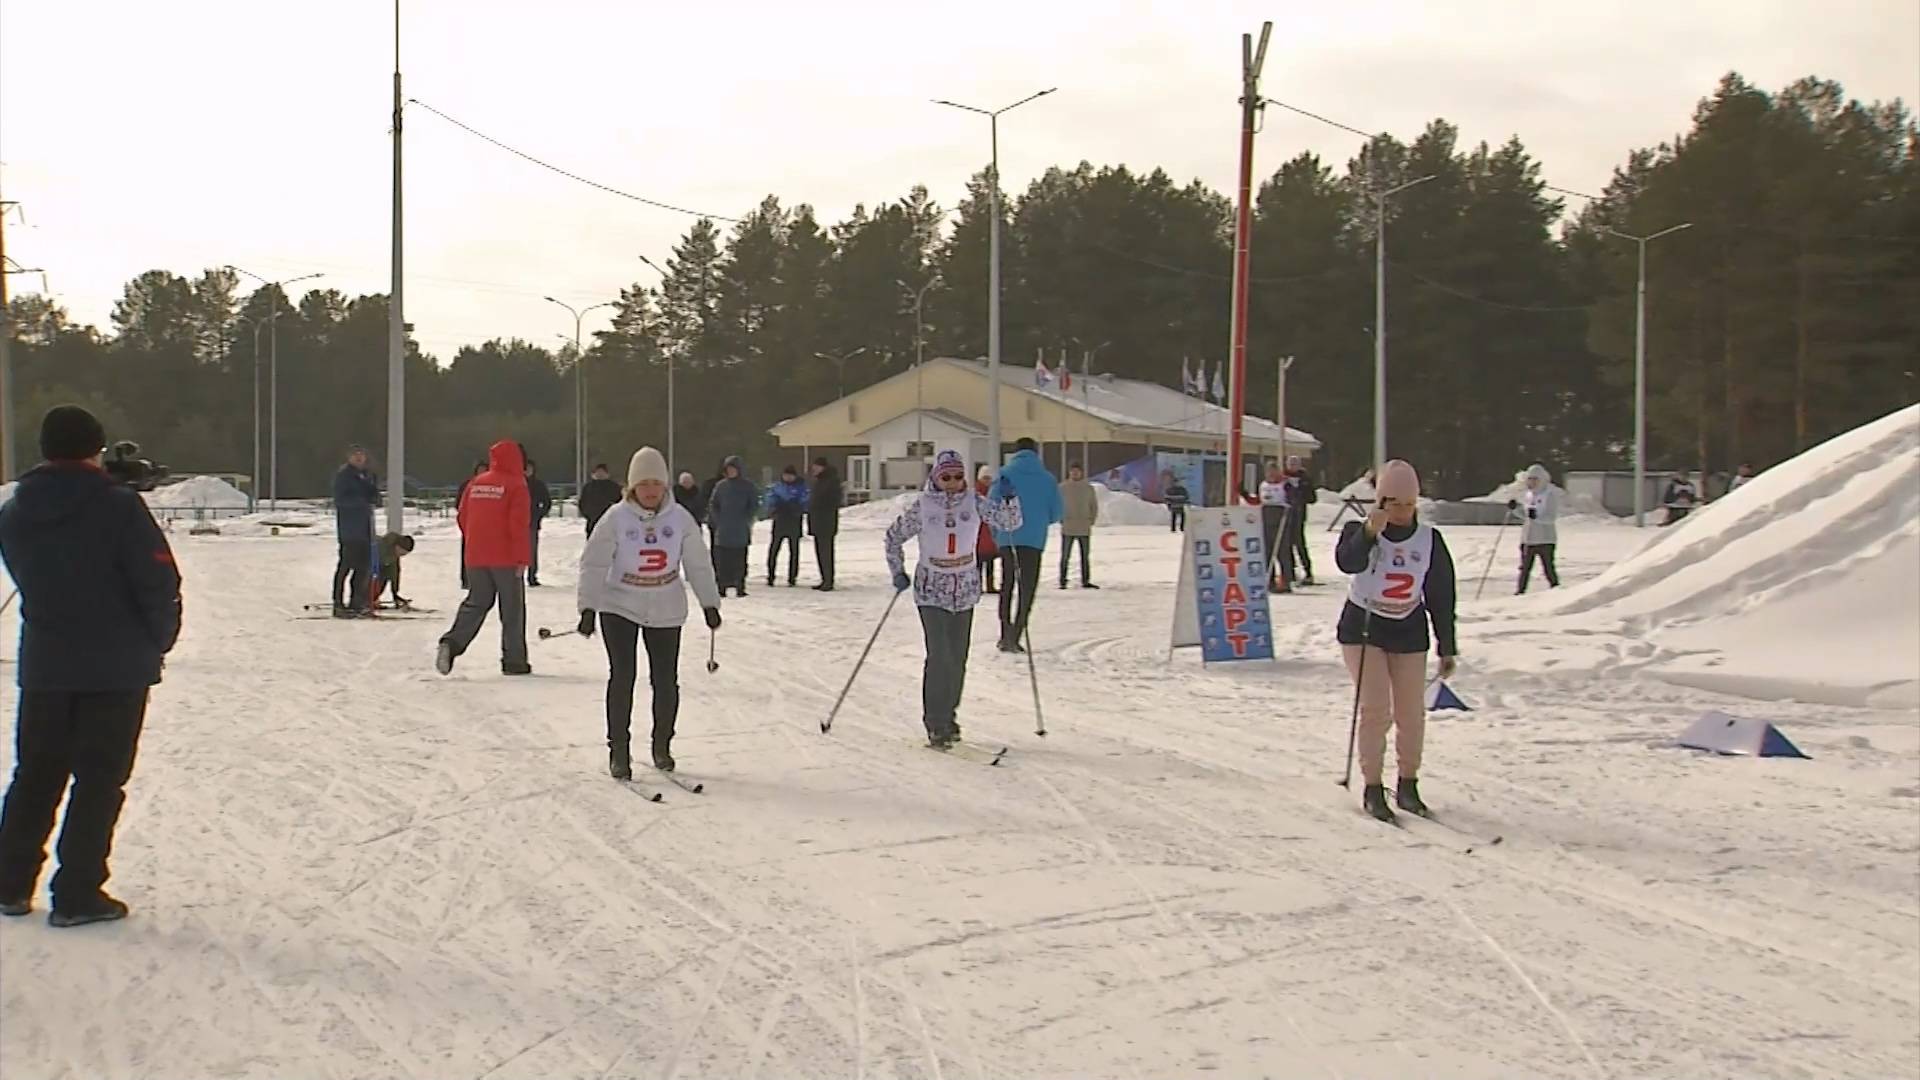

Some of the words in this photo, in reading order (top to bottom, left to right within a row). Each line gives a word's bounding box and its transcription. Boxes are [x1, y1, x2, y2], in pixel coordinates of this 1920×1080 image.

[638, 549, 668, 572] 3
[1218, 530, 1251, 656] СТАРТ
[1381, 572, 1415, 600] 2
